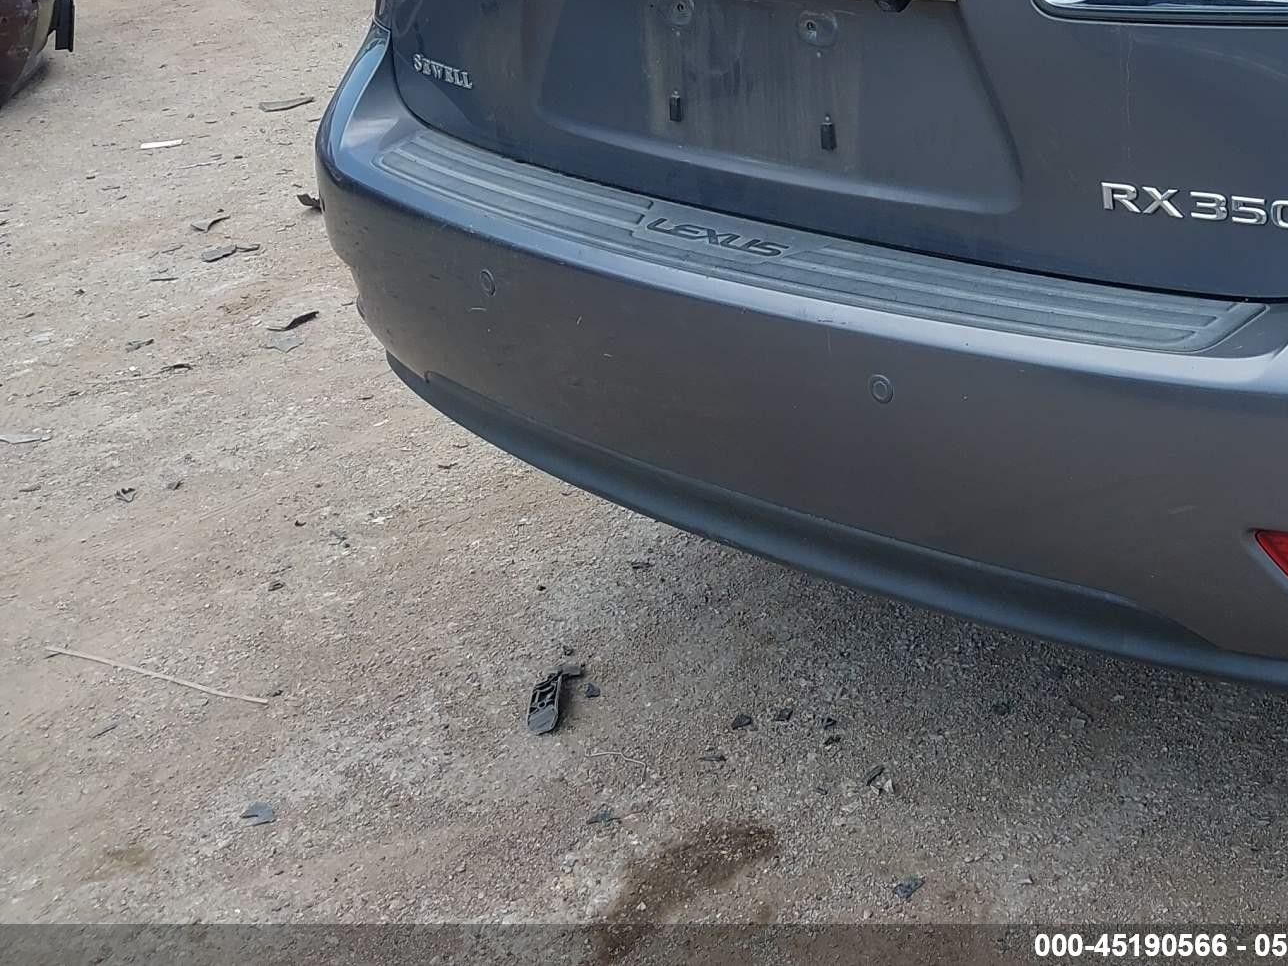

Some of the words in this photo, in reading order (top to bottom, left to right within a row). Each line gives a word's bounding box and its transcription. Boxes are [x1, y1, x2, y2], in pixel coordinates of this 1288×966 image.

[413, 53, 473, 89] SEWELL
[1100, 181, 1185, 219] RX
[646, 217, 790, 257] LEXUS
